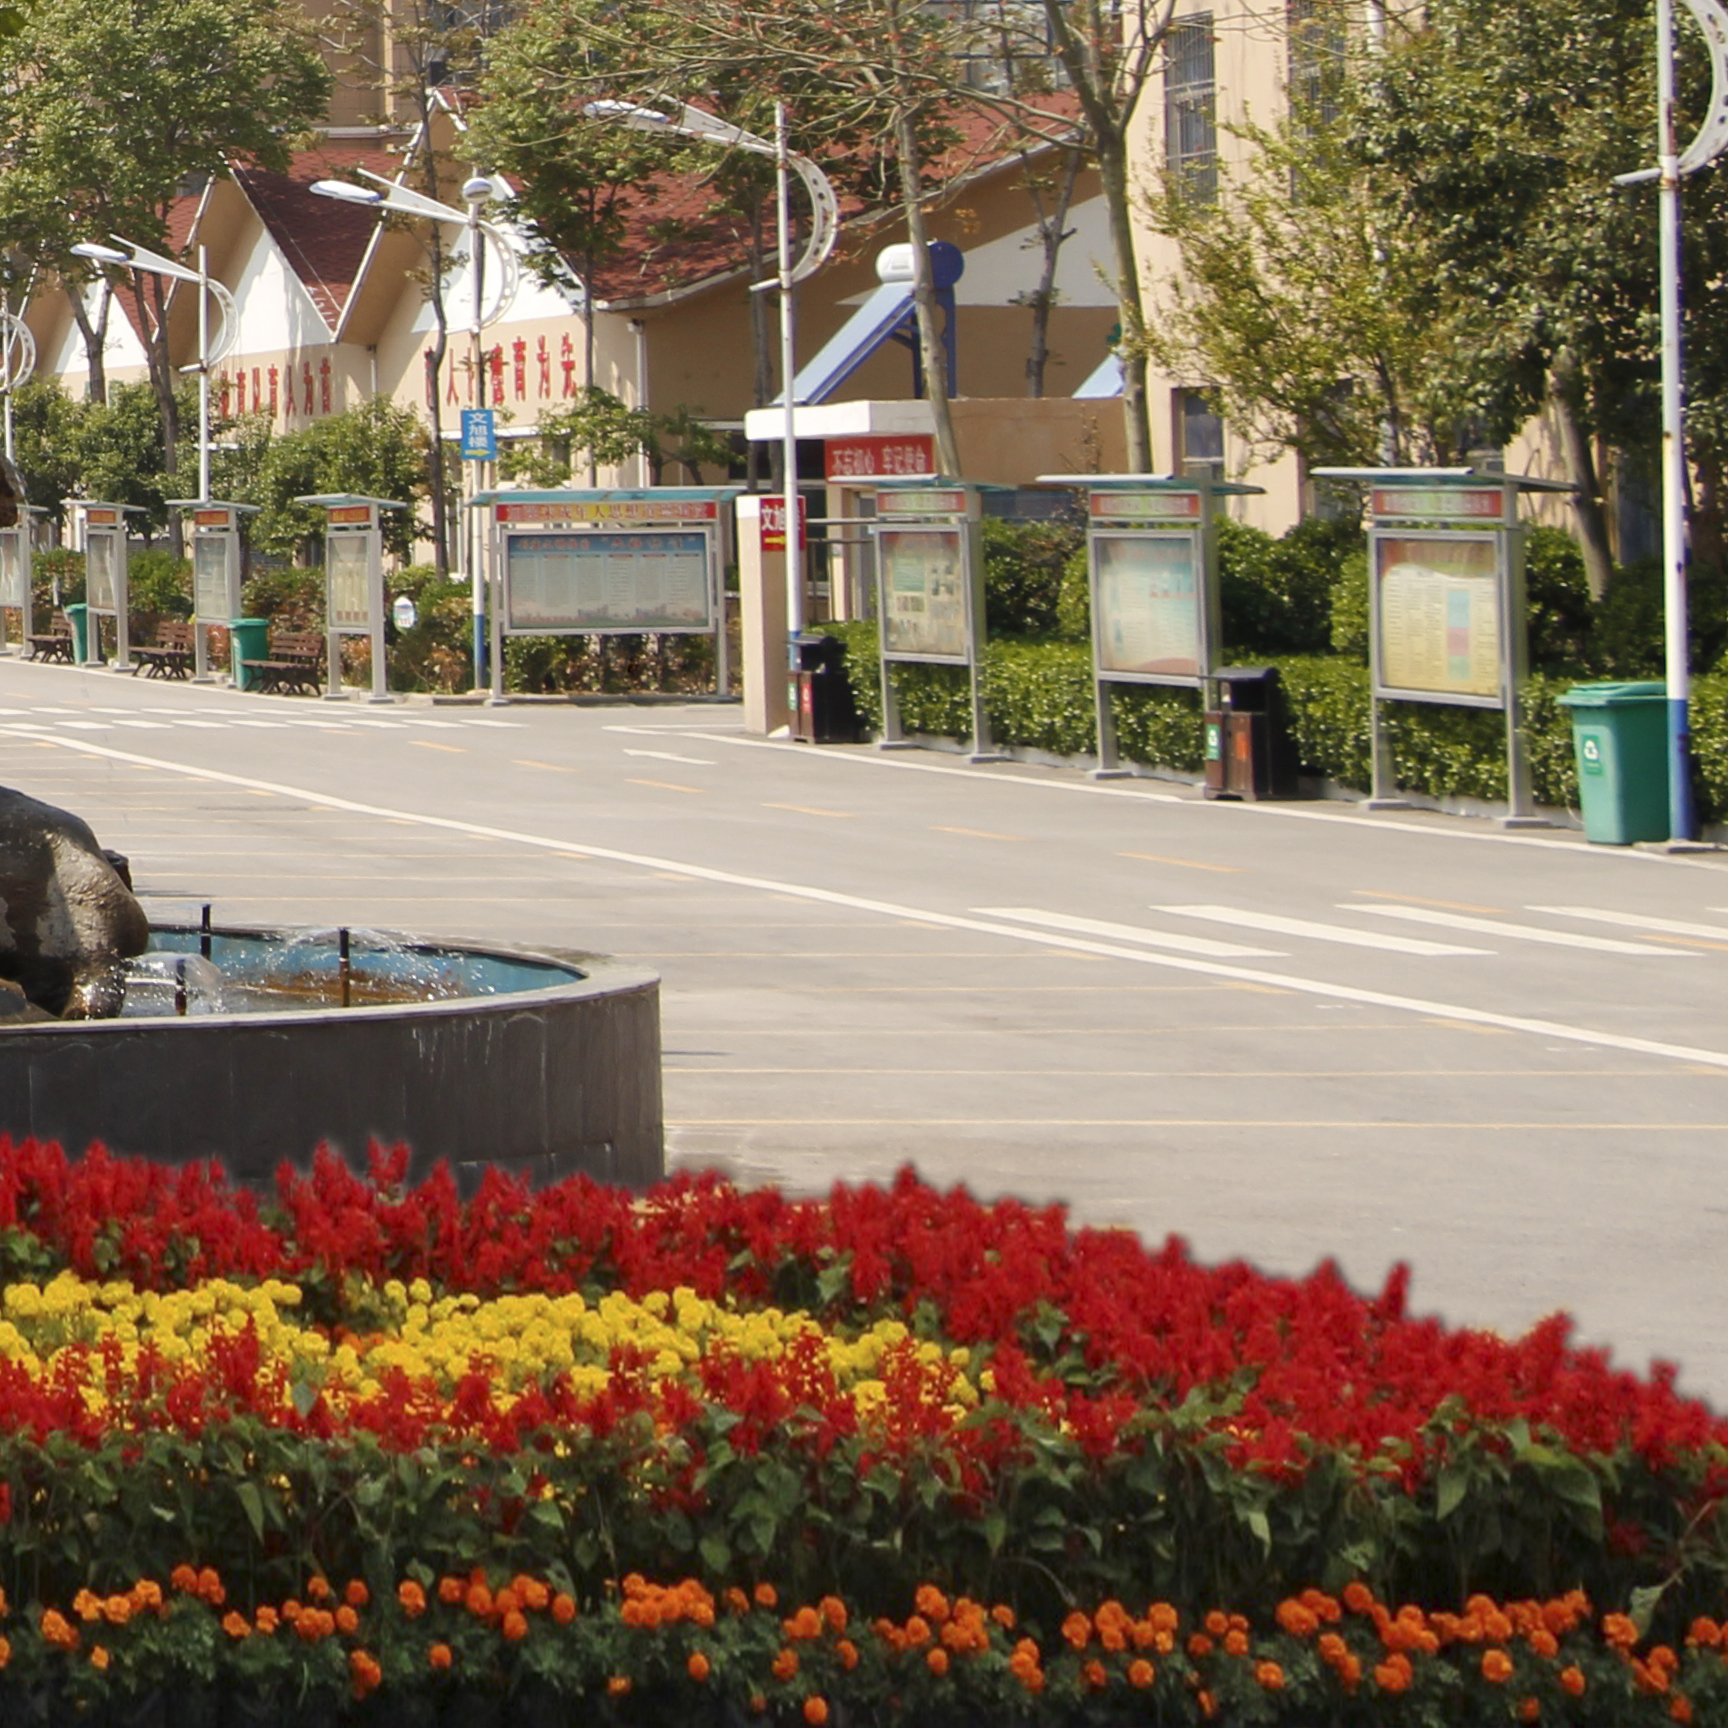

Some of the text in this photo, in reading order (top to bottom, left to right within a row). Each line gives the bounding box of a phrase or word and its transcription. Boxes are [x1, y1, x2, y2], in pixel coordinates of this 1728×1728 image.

[832, 444, 926, 475] 不忘初心 牢记使命
